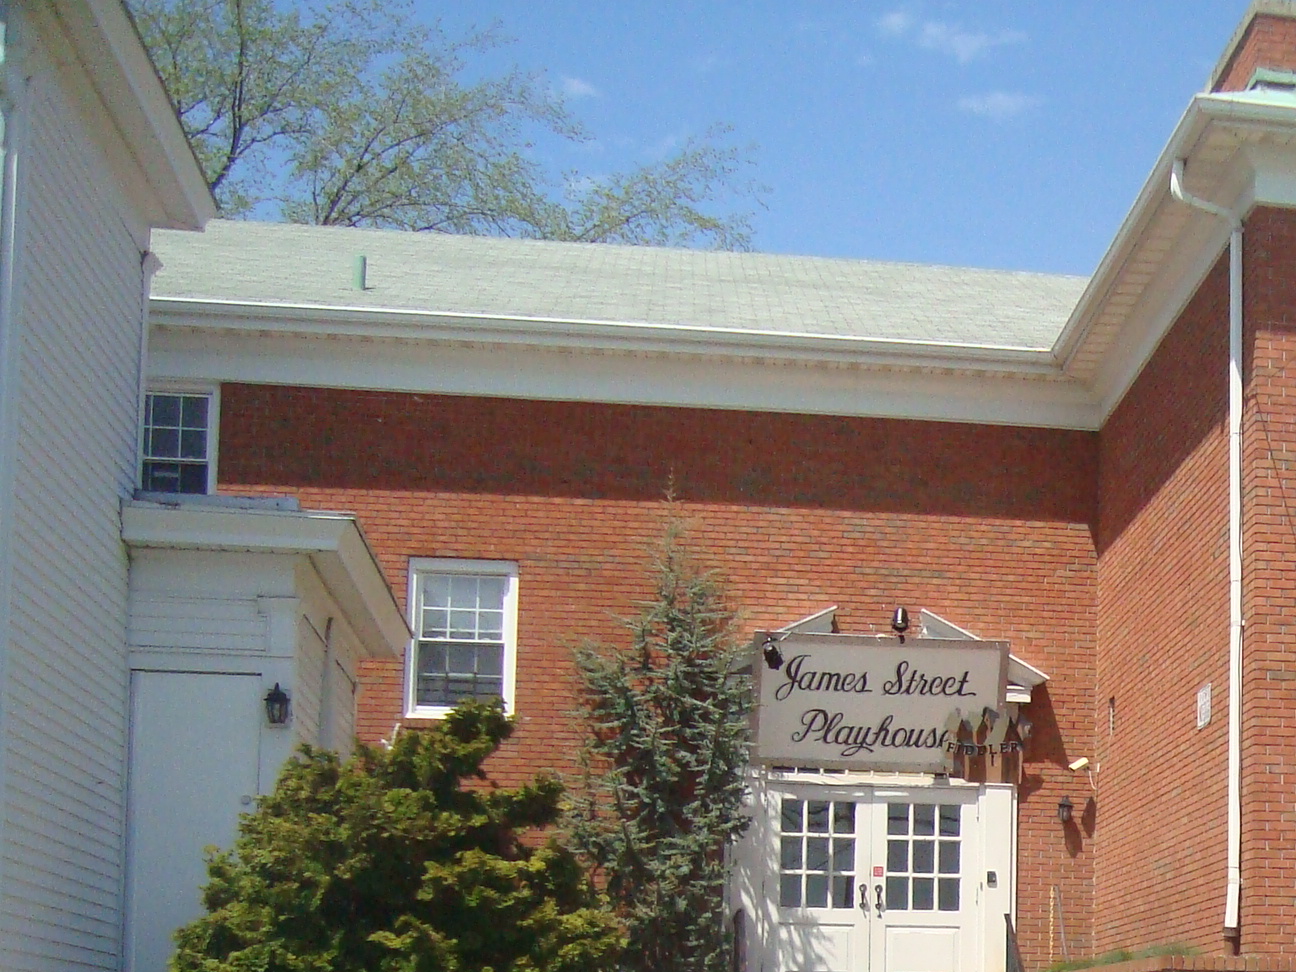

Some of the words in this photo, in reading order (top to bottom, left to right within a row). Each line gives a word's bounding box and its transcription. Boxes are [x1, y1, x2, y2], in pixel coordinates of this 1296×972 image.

[775, 654, 872, 701] James
[882, 660, 977, 696] Street
[946, 740, 1021, 756] FIDDLER
